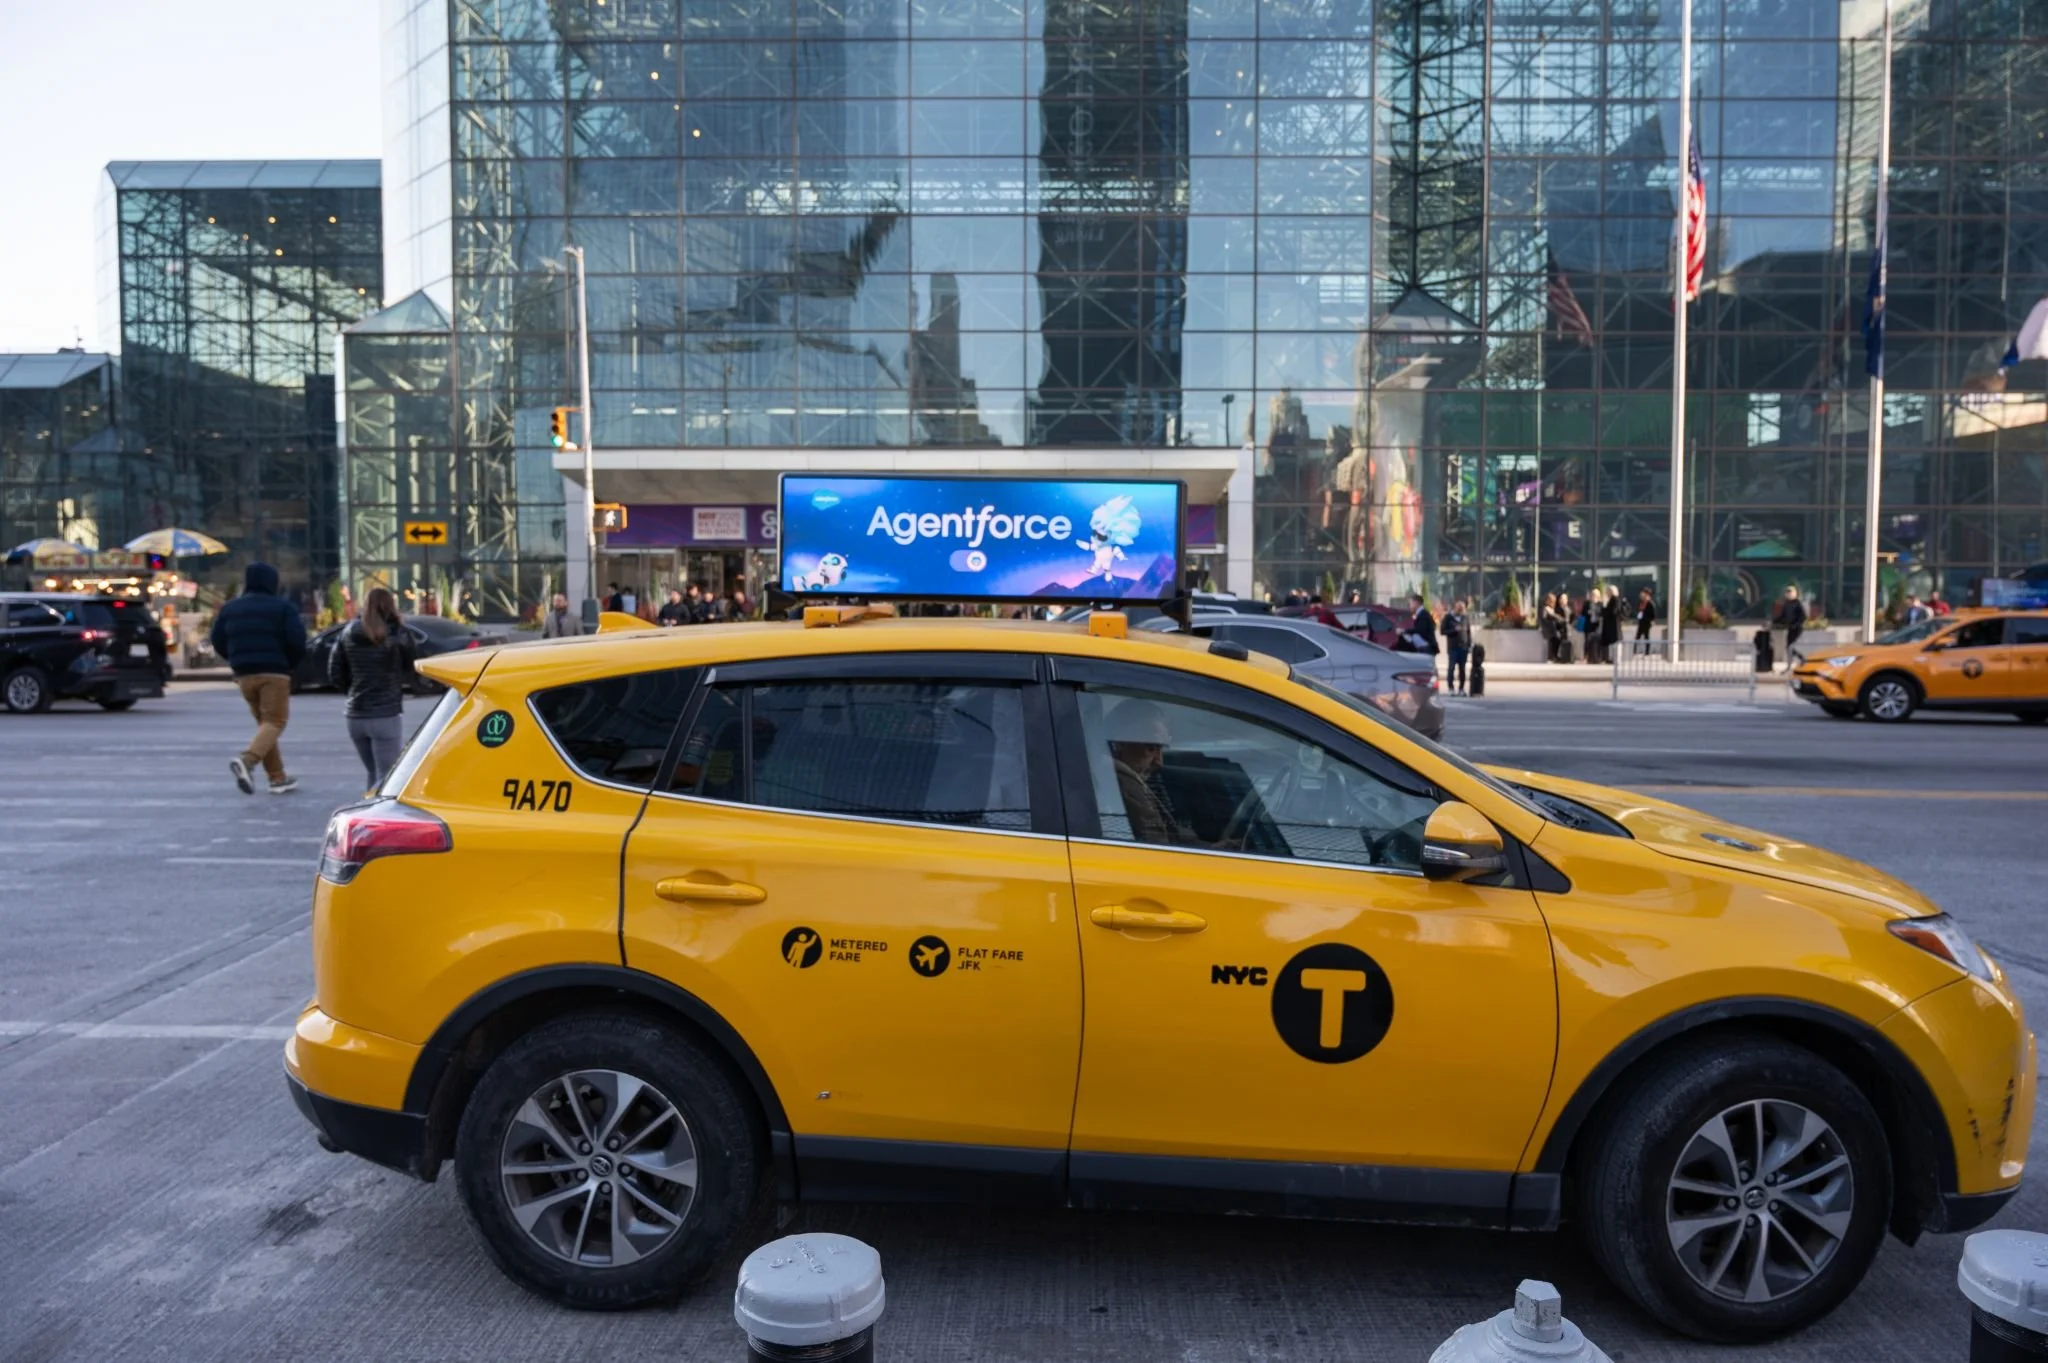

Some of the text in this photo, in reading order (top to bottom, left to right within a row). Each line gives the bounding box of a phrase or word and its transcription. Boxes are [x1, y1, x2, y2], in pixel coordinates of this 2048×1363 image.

[866, 504, 1072, 548] Agentforce
[503, 778, 572, 812] 9A70
[830, 938, 888, 952] METERED
[829, 950, 861, 962] FARE
[958, 947, 1024, 961] FLAT FARE
[957, 960, 981, 971] JFK
[1211, 964, 1367, 1049] NYC T
